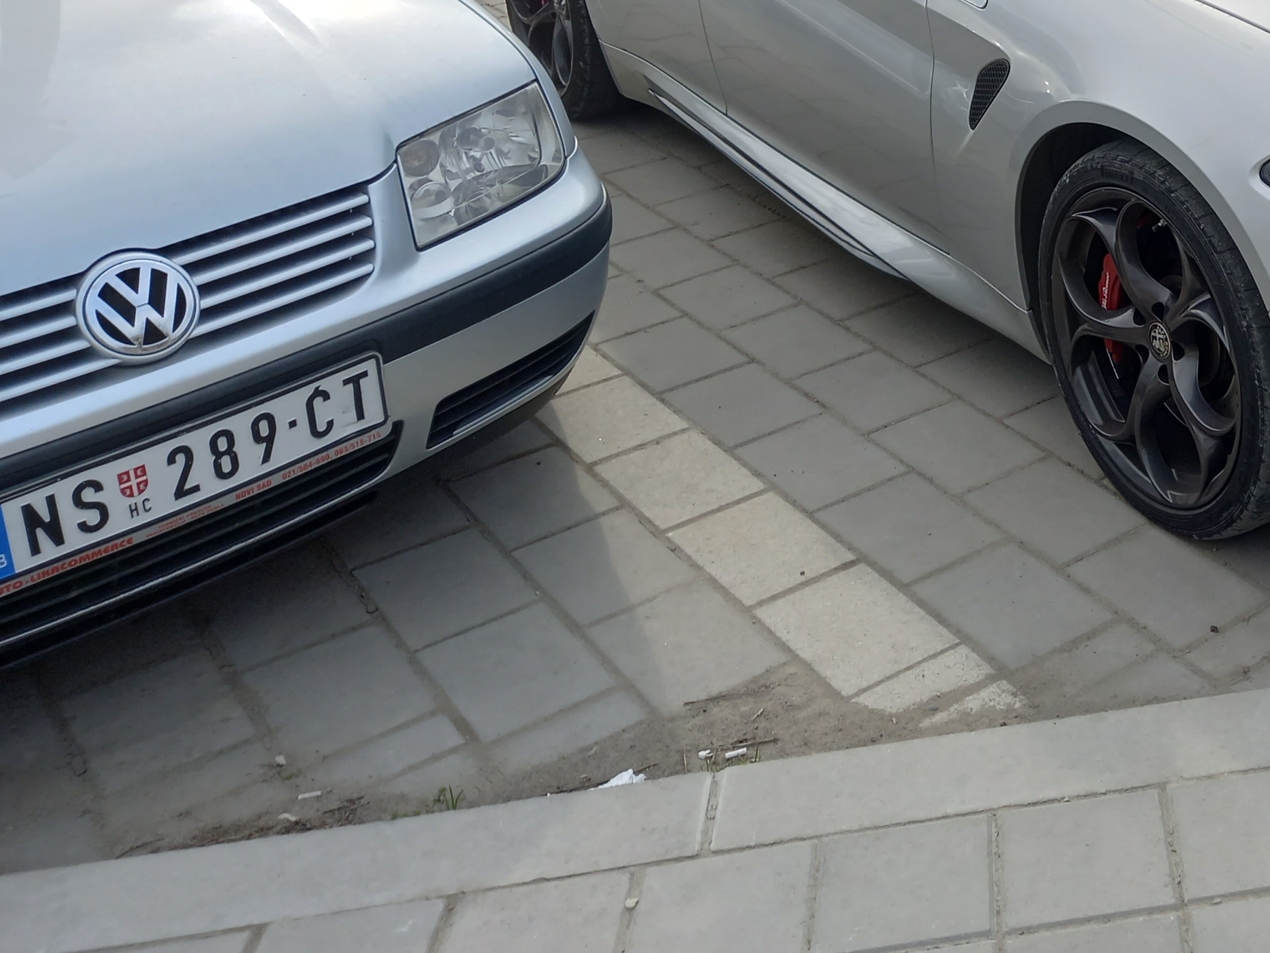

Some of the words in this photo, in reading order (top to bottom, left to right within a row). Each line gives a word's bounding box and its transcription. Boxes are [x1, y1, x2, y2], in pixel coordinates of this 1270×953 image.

[83, 258, 193, 354] VW
[20, 479, 110, 557] NS
[235, 487, 255, 500] NOVI
[257, 479, 272, 491] SAD
